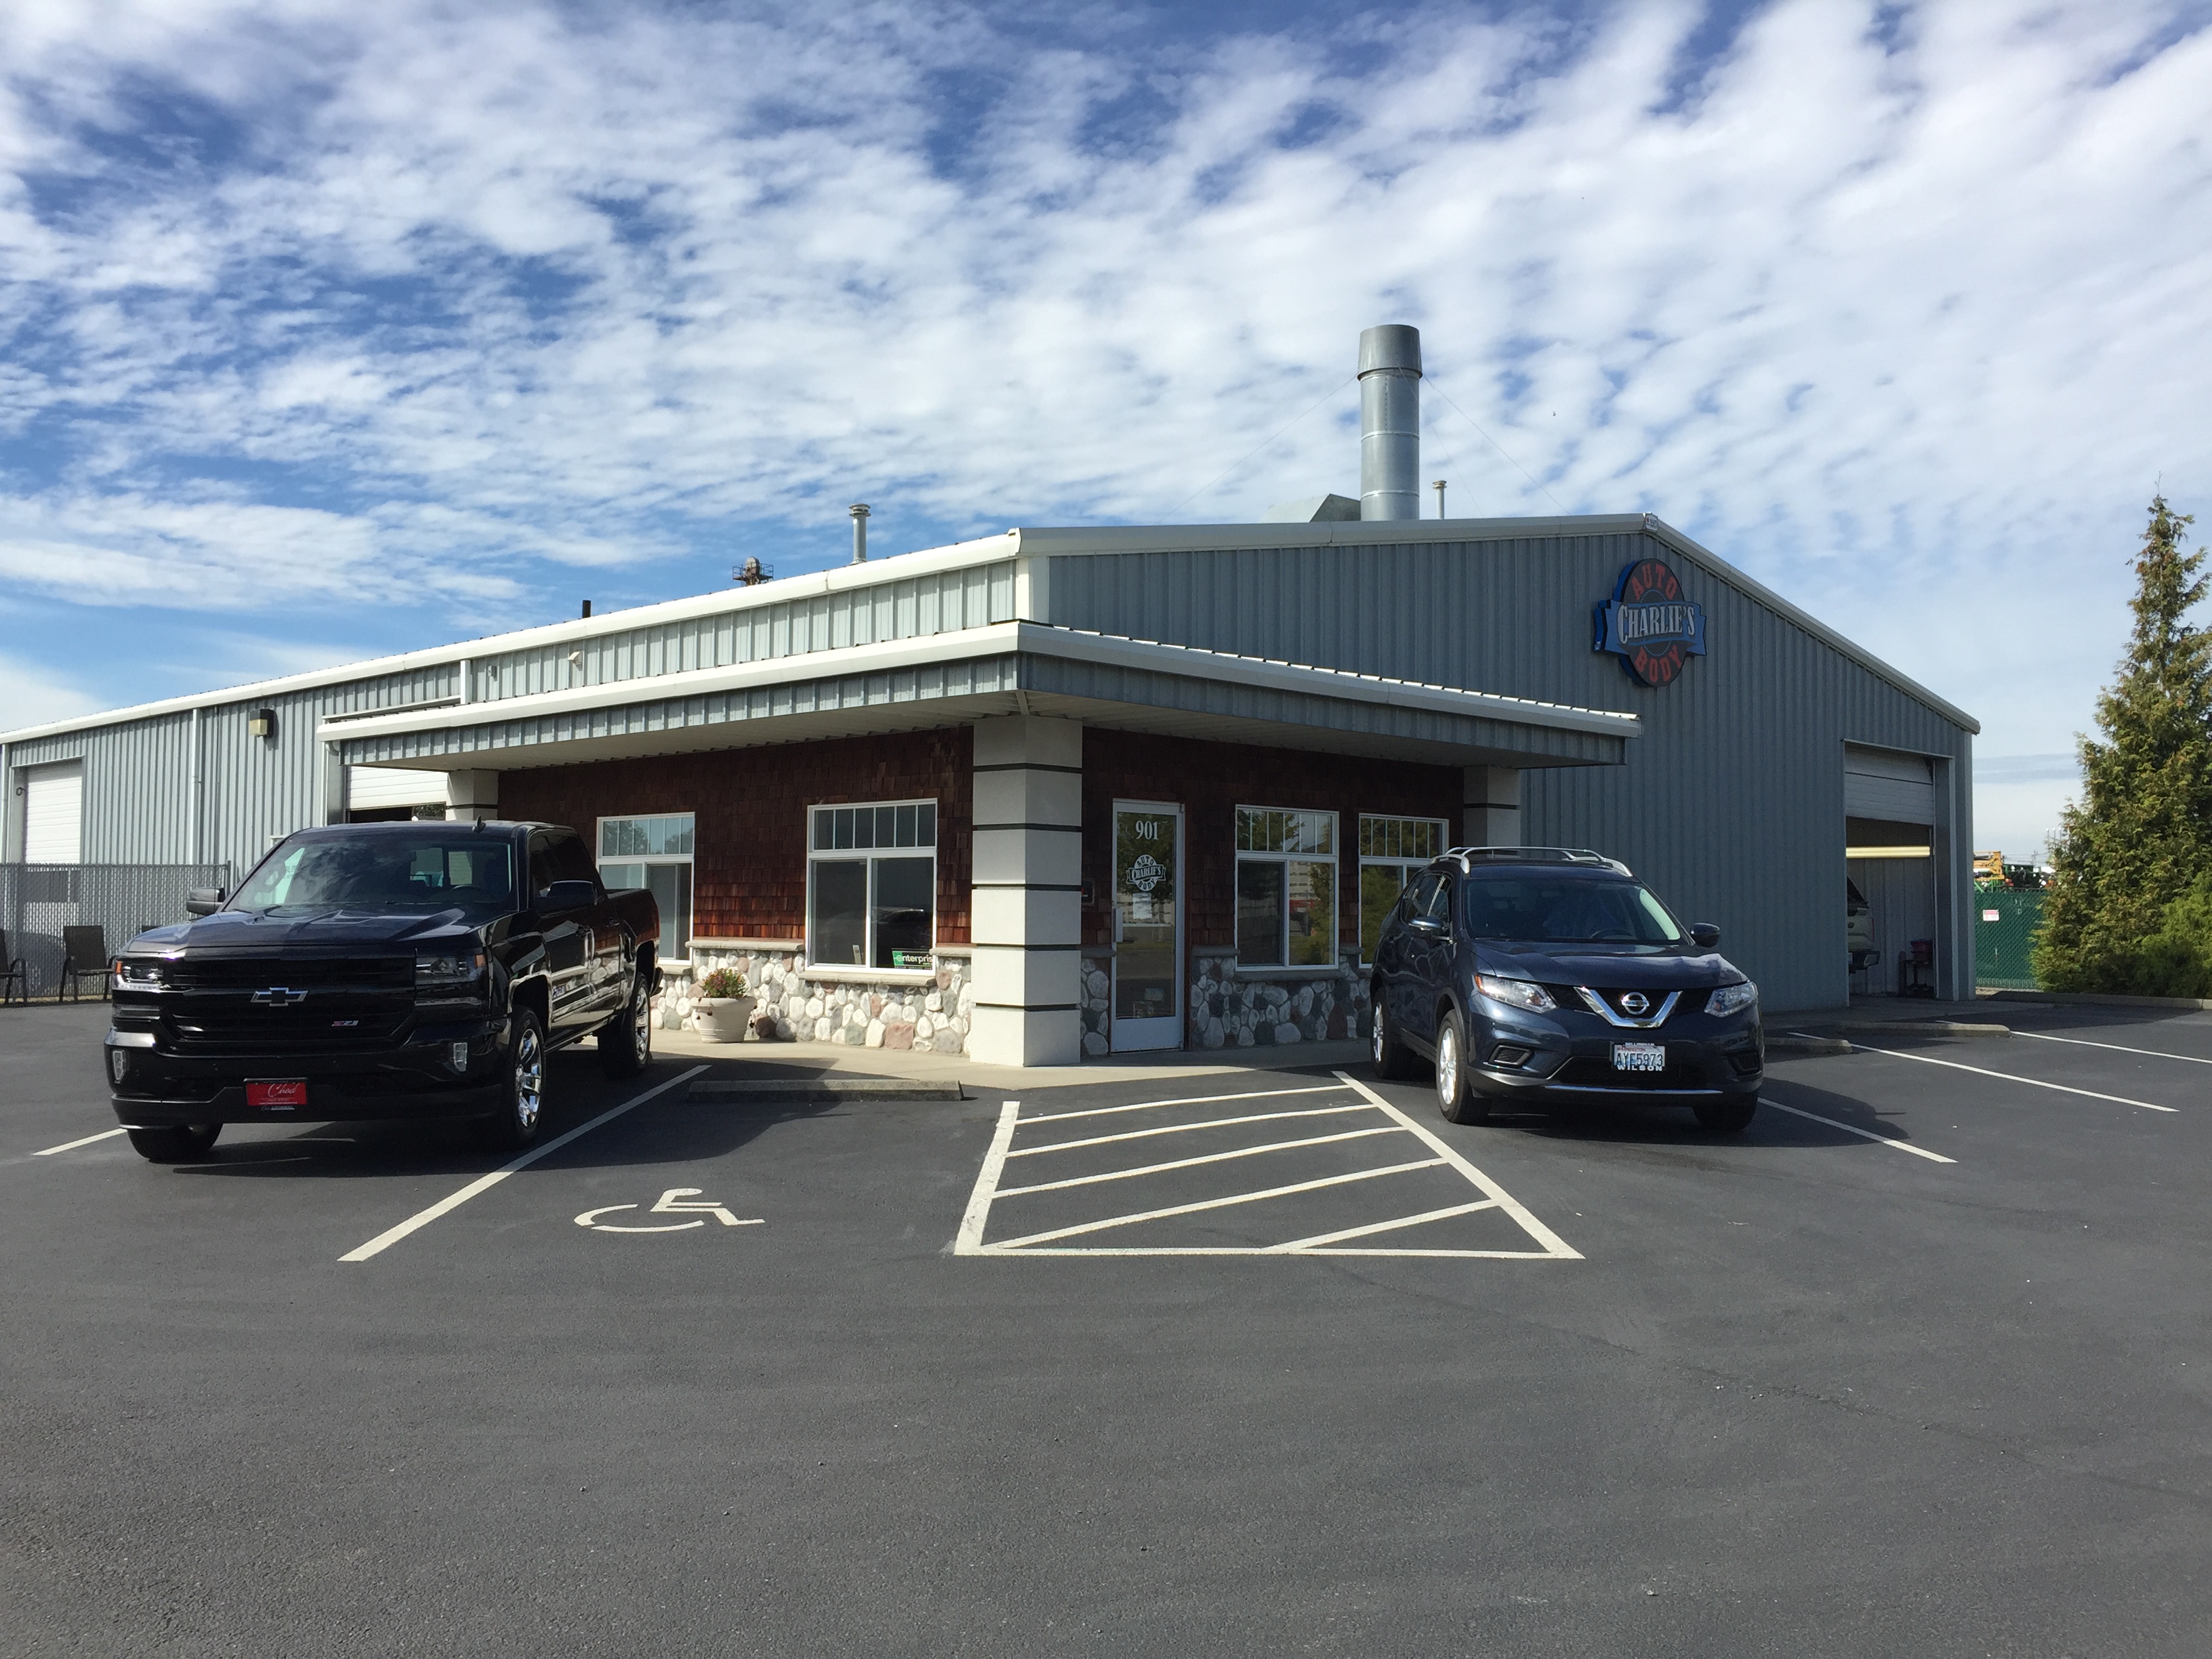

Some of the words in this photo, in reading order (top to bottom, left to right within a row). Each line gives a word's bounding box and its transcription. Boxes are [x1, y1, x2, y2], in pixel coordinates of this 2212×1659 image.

[1631, 563, 1677, 600] AUTO
[1617, 605, 1695, 644] CHARLIE'S
[1635, 644, 1681, 682] BODY
[1135, 820, 1159, 840] 901
[1136, 856, 1154, 867] AUTO
[1131, 865, 1161, 881] CHARLIE'S
[1138, 878, 1155, 890] BODY
[896, 954, 933, 964] enterpris
